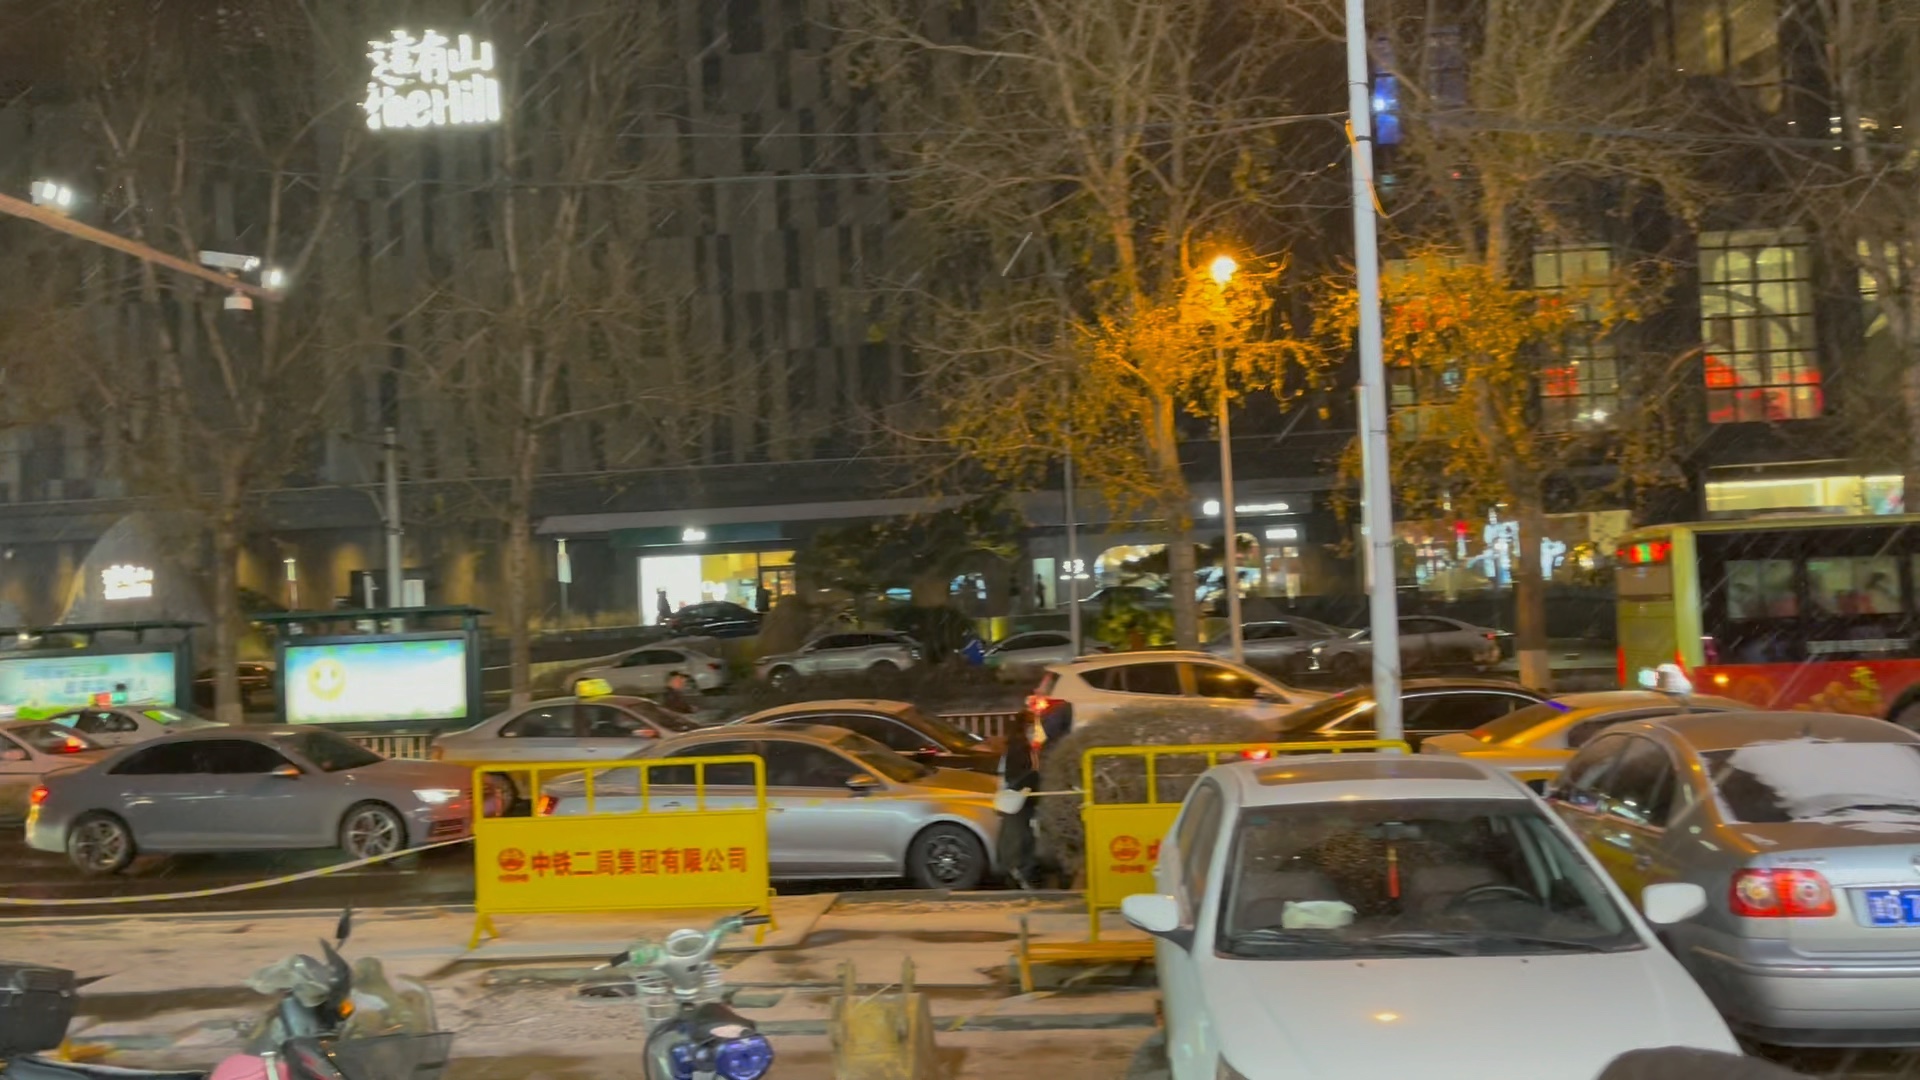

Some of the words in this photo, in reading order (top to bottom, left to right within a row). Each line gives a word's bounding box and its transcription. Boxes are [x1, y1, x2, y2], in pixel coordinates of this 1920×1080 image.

[531, 847, 747, 877] 中铁二局集团有限公司
